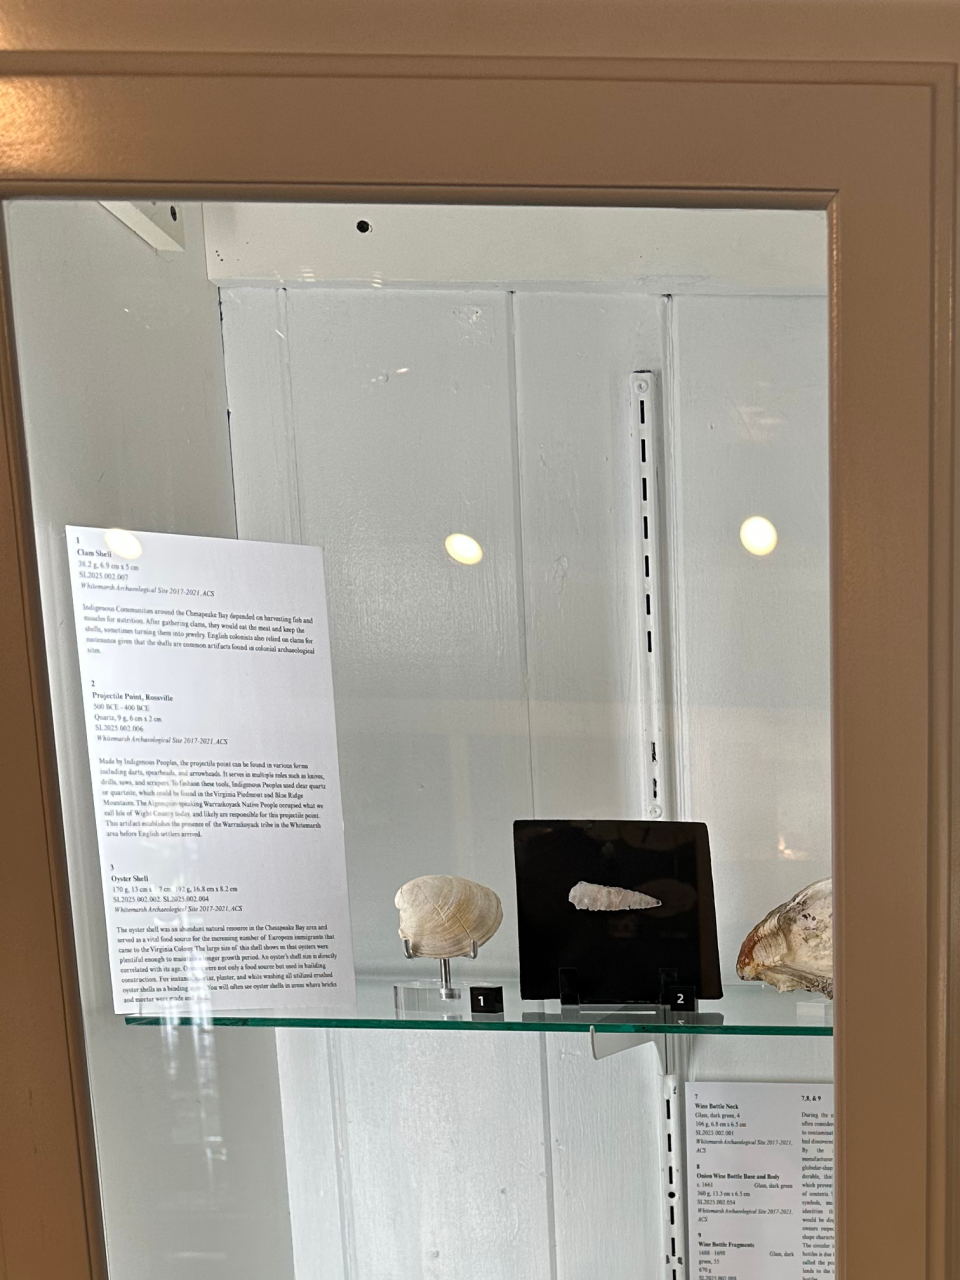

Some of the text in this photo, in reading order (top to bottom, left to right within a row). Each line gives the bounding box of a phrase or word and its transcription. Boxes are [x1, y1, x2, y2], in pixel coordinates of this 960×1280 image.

[76, 548, 112, 557] Clam Shell
[92, 691, 123, 699] Projectile
[145, 693, 173, 701] Rossville
[478, 995, 484, 1007] 1
[677, 993, 685, 1004] 2
[766, 1173, 780, 1181] Body
